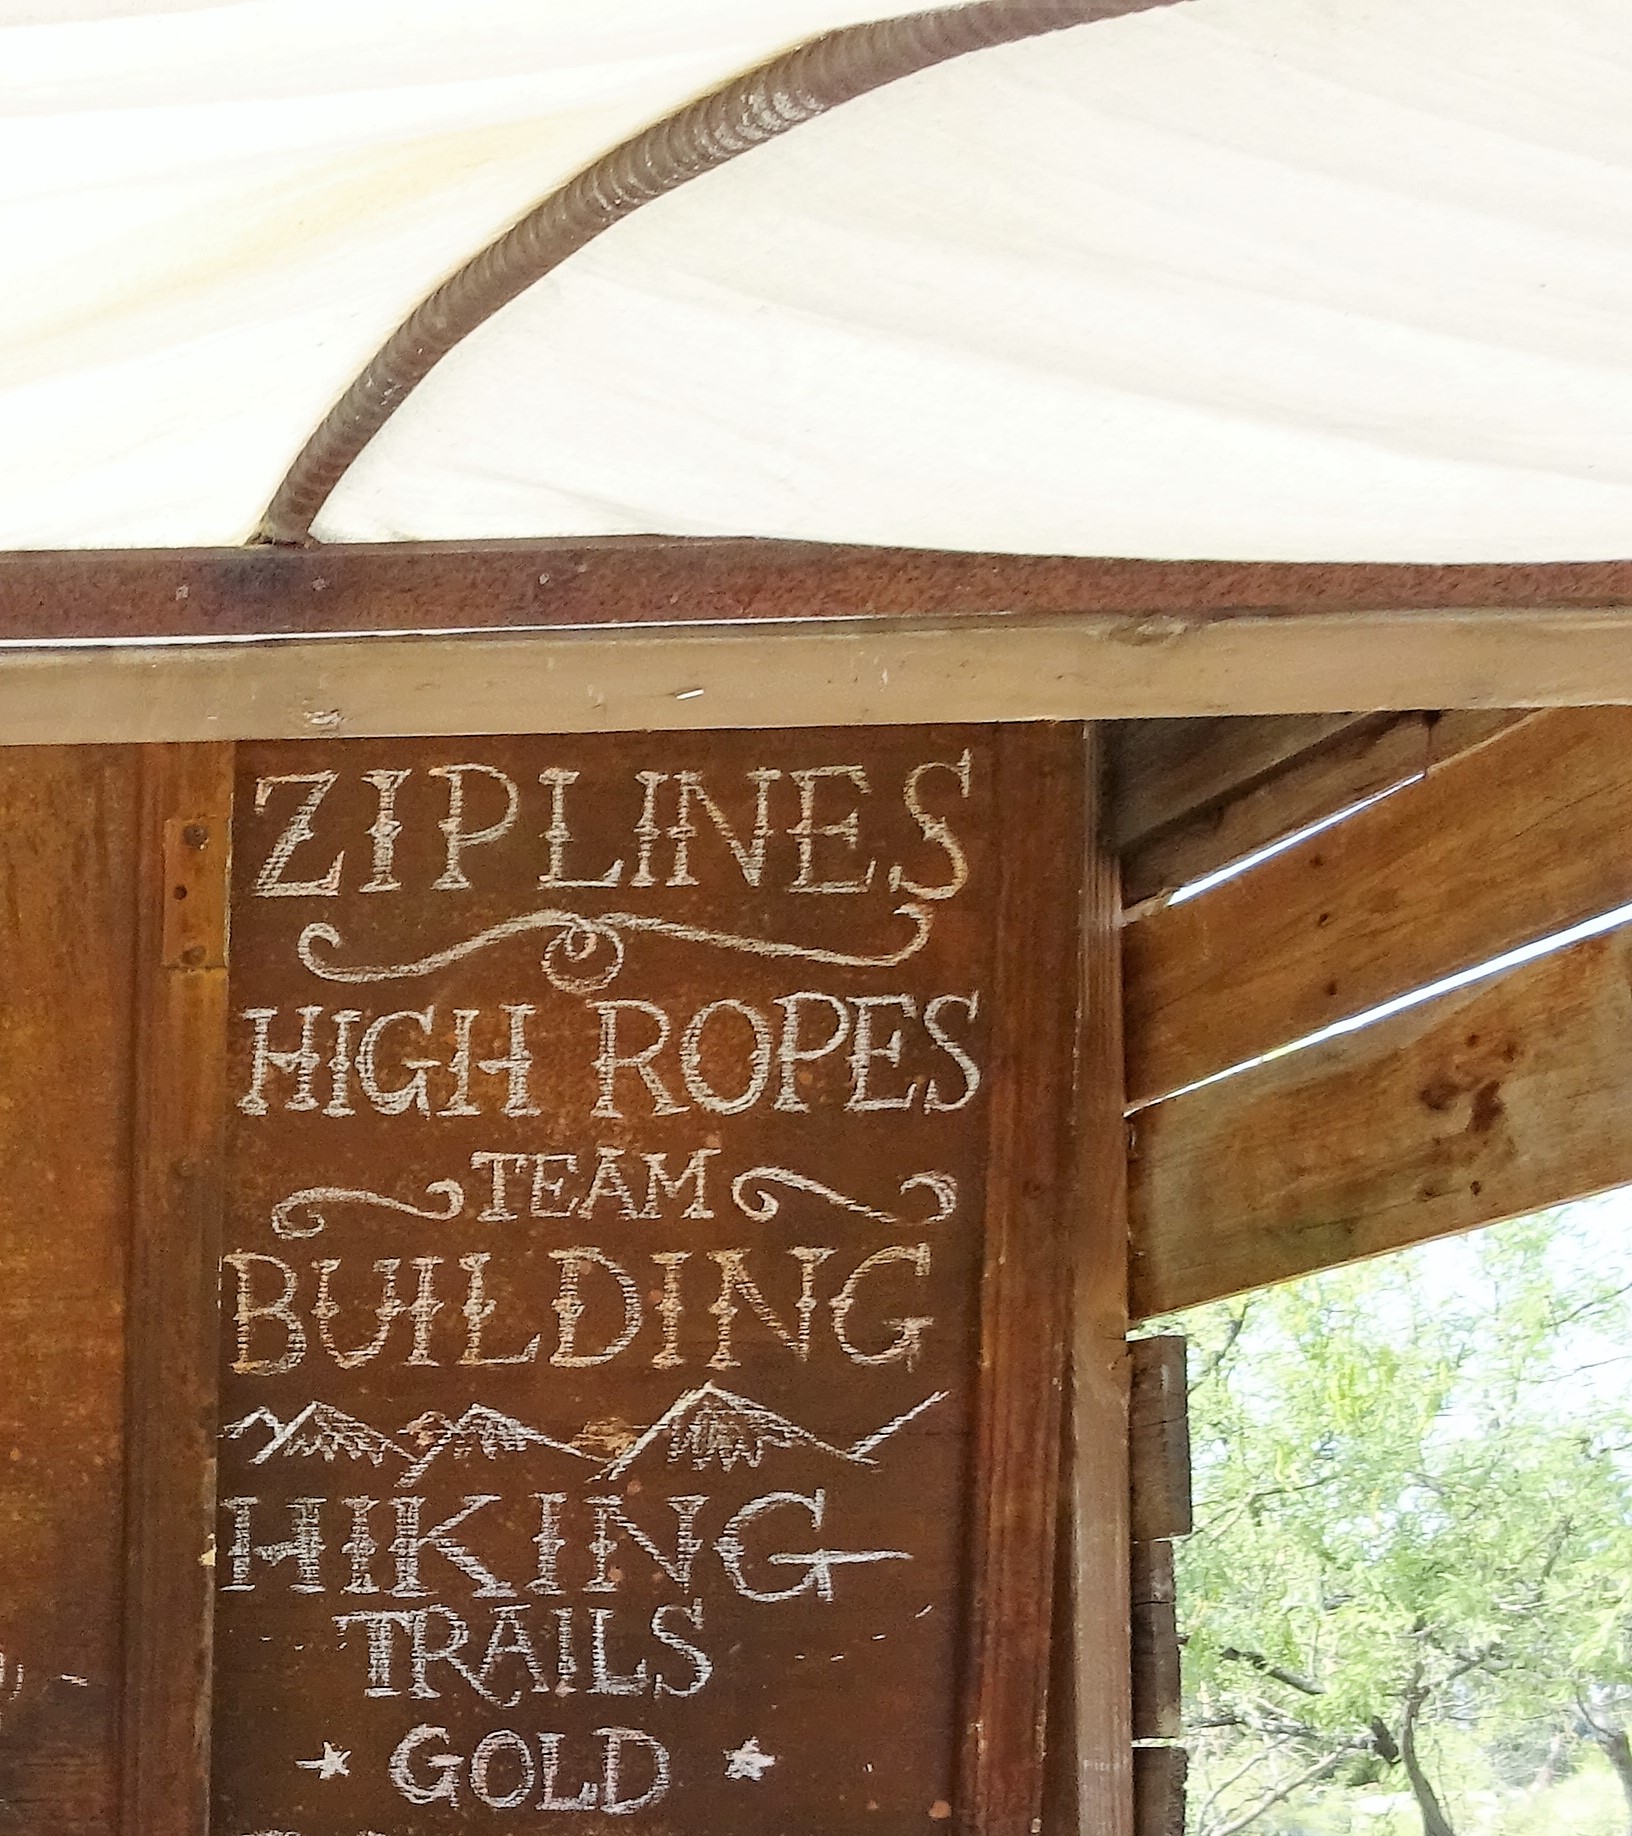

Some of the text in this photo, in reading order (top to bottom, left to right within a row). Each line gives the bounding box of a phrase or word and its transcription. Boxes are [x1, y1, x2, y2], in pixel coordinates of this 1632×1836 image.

[252, 749, 973, 900] ZIPLINES
[235, 990, 982, 1118] HIGH ROPES
[470, 1146, 722, 1222] TEAM
[223, 1242, 935, 1376] BUILDING
[218, 1488, 913, 1602] HIKING
[335, 1598, 714, 1708] TRAILS
[388, 1724, 672, 1815] GOLD
